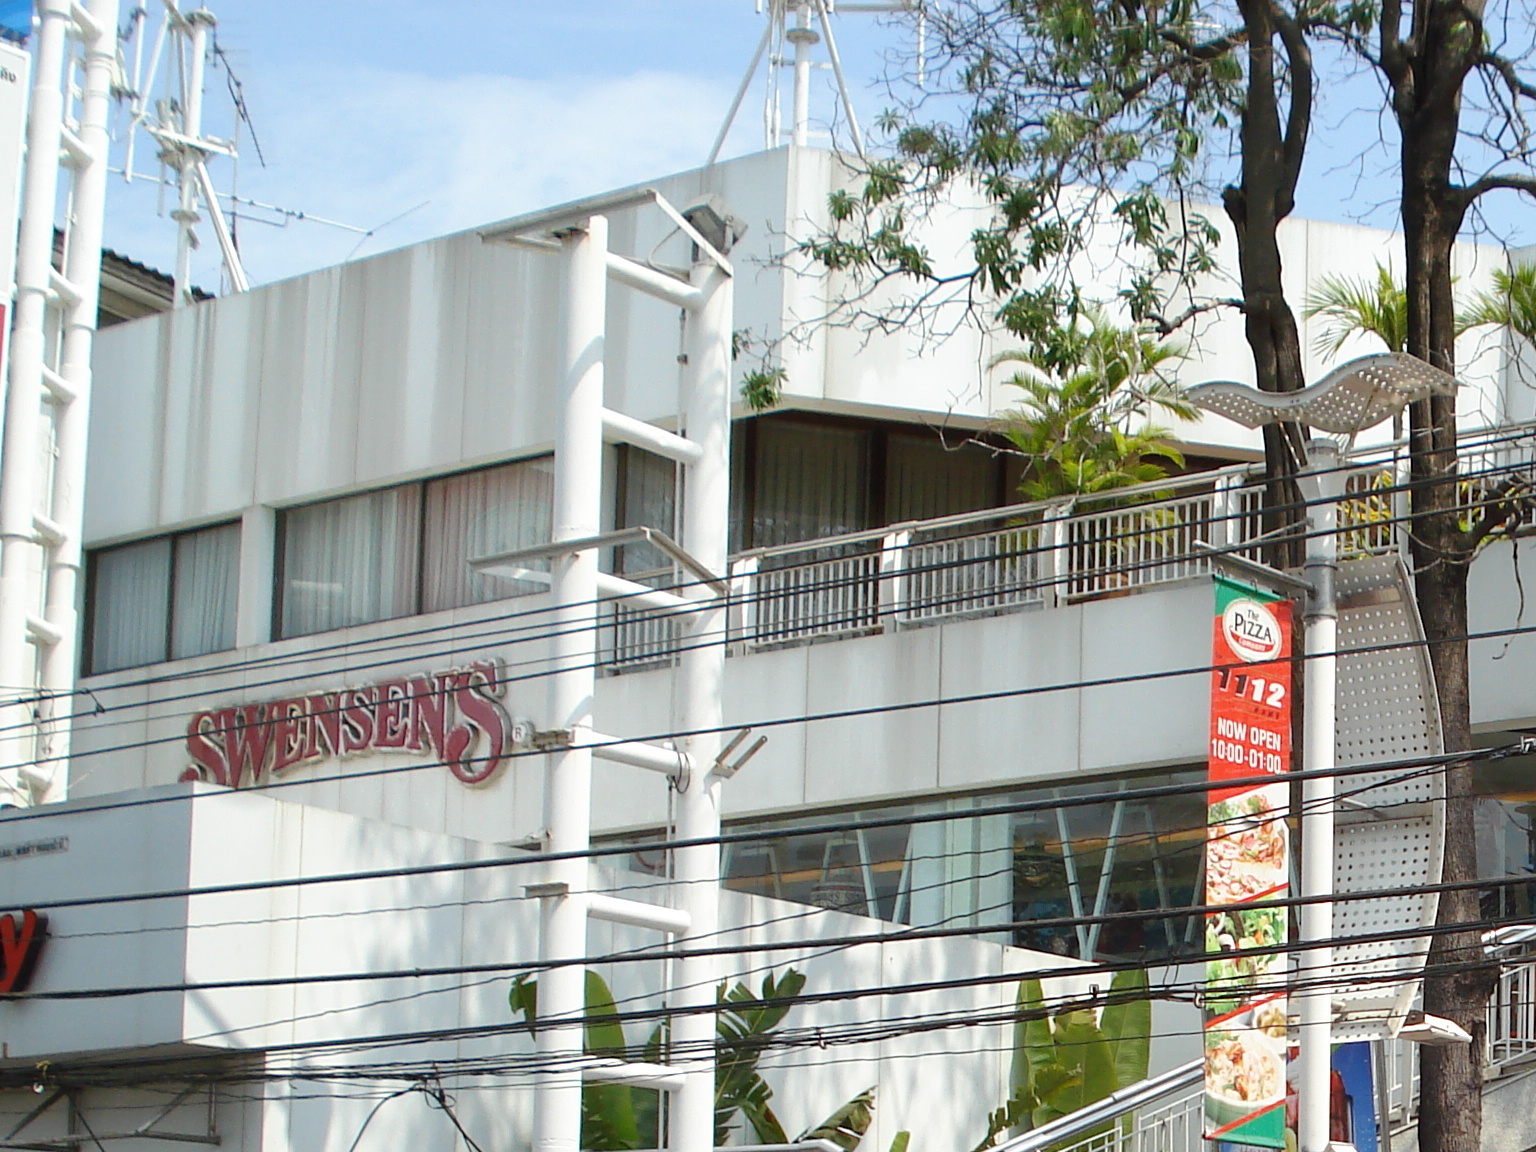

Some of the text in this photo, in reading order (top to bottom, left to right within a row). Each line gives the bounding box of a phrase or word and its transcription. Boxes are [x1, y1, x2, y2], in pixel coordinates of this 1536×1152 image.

[1234, 612, 1272, 642] PIZZA
[1218, 667, 1286, 708] 1112
[178, 657, 508, 788] SWENSEN'S
[1217, 716, 1281, 752] NOW OPEN
